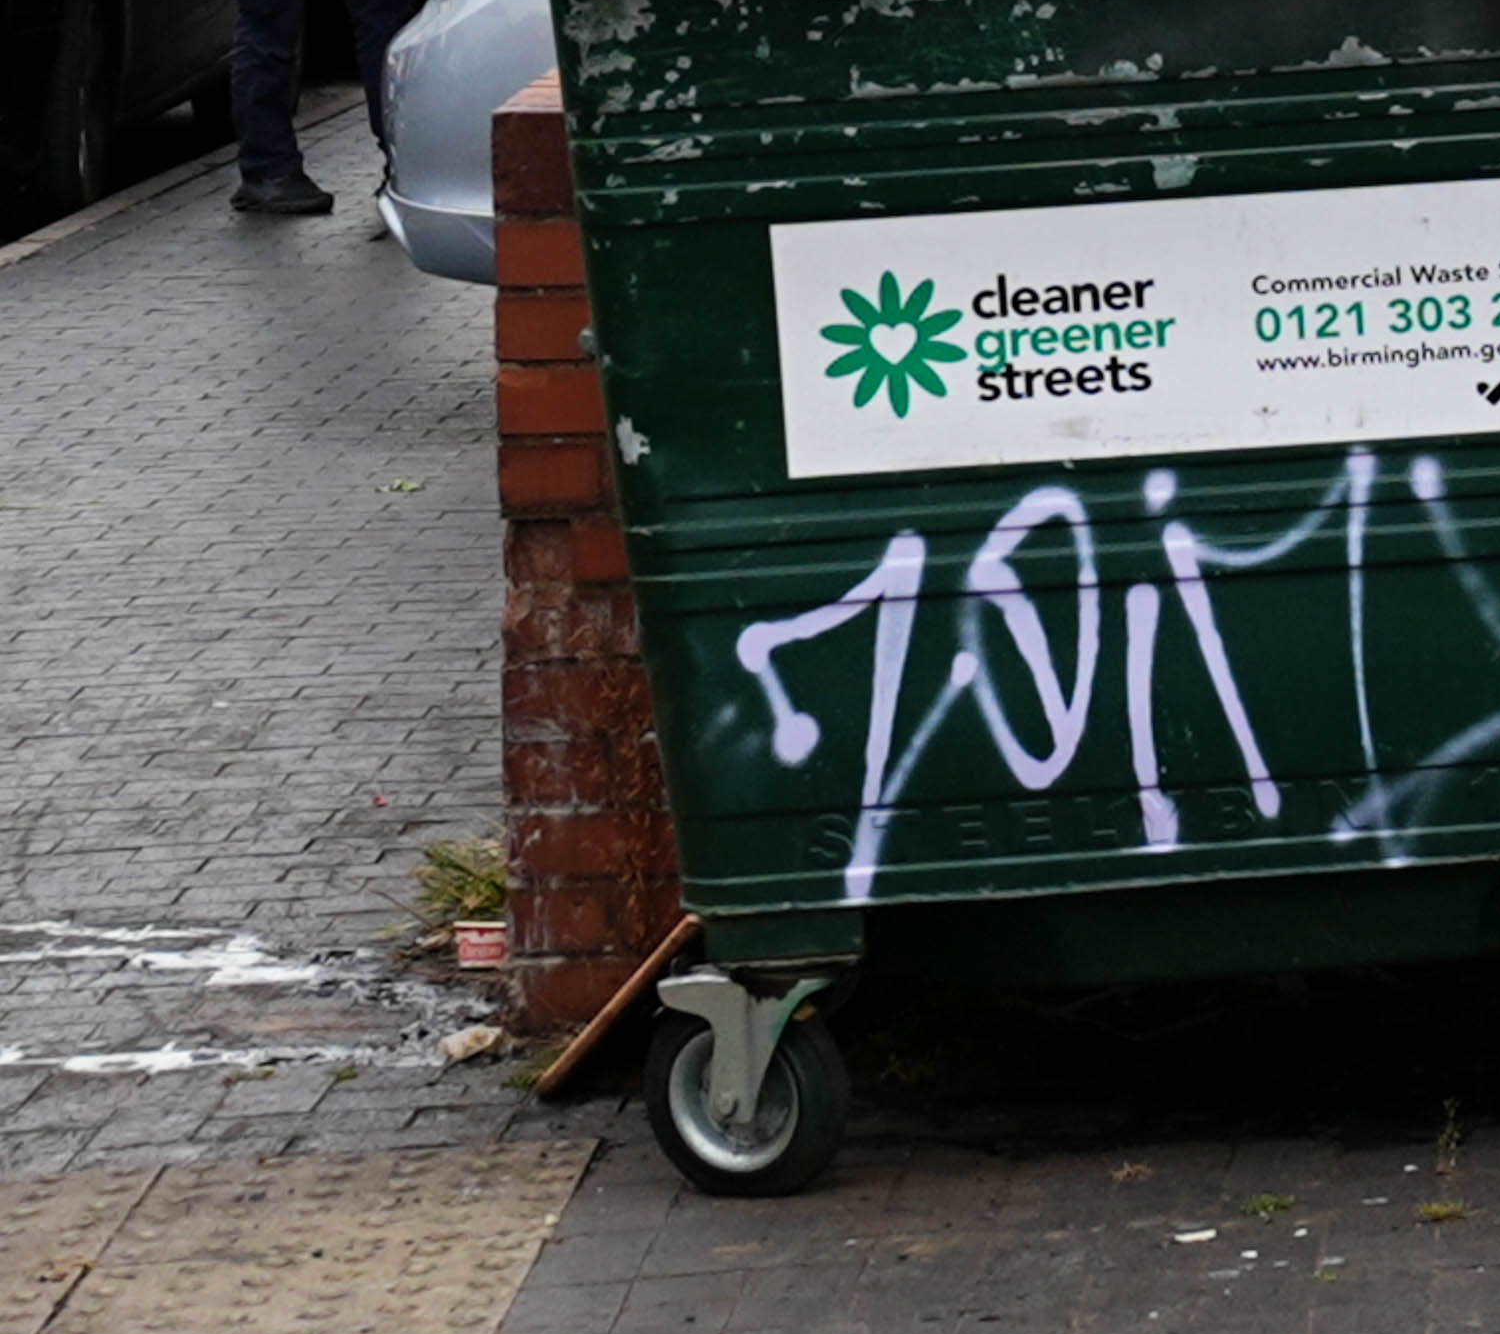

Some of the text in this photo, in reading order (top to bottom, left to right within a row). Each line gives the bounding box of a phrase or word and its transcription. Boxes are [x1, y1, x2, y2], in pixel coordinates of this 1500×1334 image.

[972, 274, 1155, 320] cleaner
[1252, 266, 1402, 296] Commercial
[1411, 263, 1490, 284] Waste
[1254, 302, 1367, 343] 0121
[1388, 294, 1473, 335] 303
[974, 317, 1176, 373] greener
[977, 356, 1152, 402] streets
